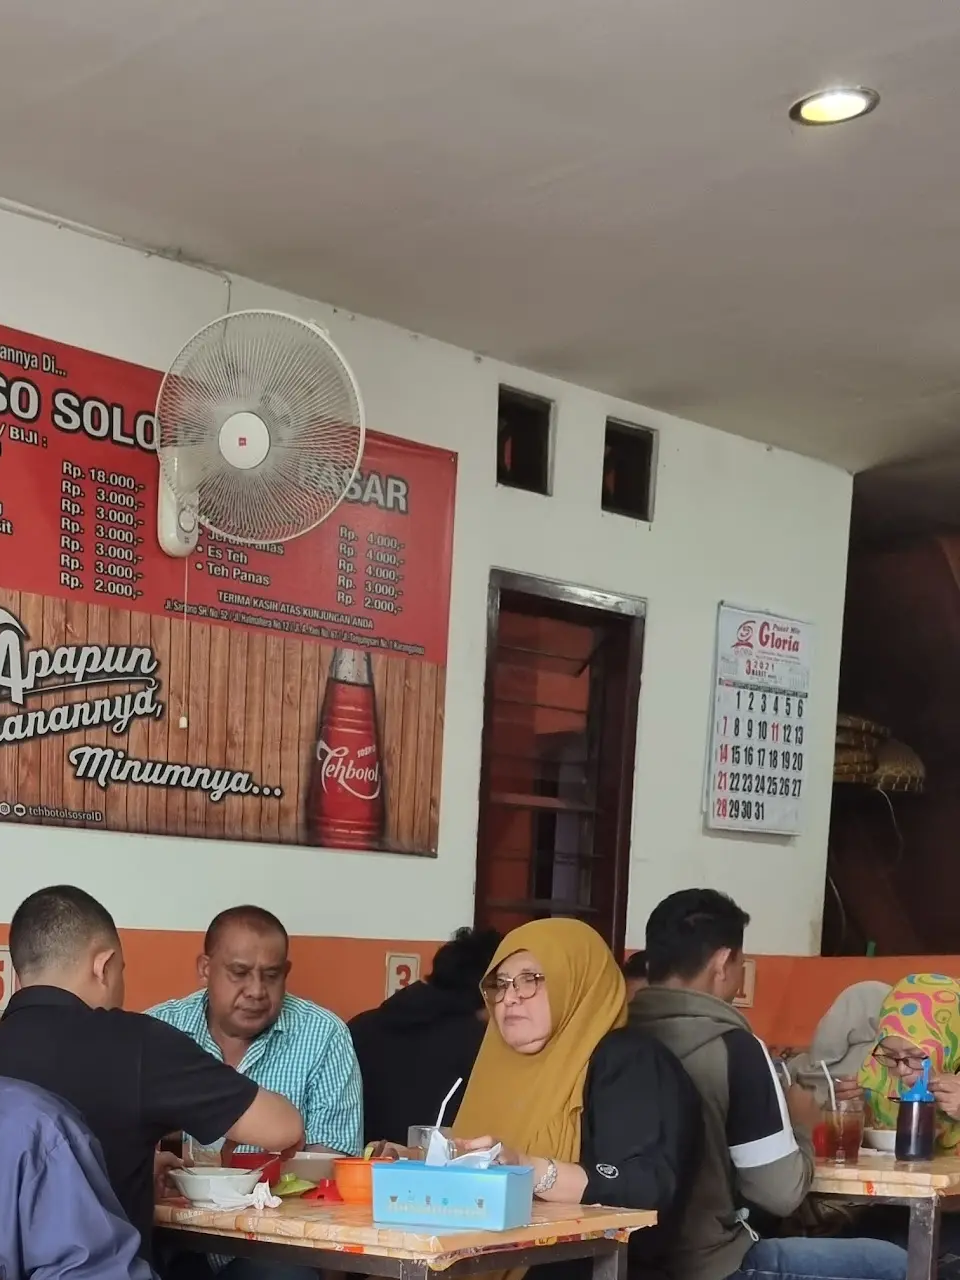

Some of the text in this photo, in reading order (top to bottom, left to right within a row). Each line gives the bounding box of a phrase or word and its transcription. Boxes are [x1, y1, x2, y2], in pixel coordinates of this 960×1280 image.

[53, 391, 162, 451] SOLO
[9, 426, 39, 446] BIJI
[62, 460, 145, 492] Rp. 18.000,-
[62, 479, 144, 511] Rp. 3.000,-
[61, 498, 144, 529] Rp. 3.000,-
[61, 517, 144, 547] Rp. 3.000,-
[61, 535, 143, 565] Rp. 3.000,-
[207, 544, 249, 565] Es Teh
[60, 553, 143, 582] Rp. 3.000,-
[206, 561, 271, 587] Teh Panas
[60, 572, 143, 601] Rp. 2.000,-
[218, 591, 374, 630] TERIMA KASIH ATAS KUNJUNGAN ANDA
[758, 621, 800, 653] Gloria
[745, 659, 751, 676] 3
[736, 691, 803, 718] 1 2 3 4 5 6
[722, 716, 804, 745] 7 8 9 10 11 12 13
[719, 744, 803, 772] 14 15 16 17 18 19 20
[68, 745, 283, 802] Minumnya...
[717, 771, 802, 798] 21 22 23 24 25 26 27
[716, 798, 764, 821] 28 29 30 31
